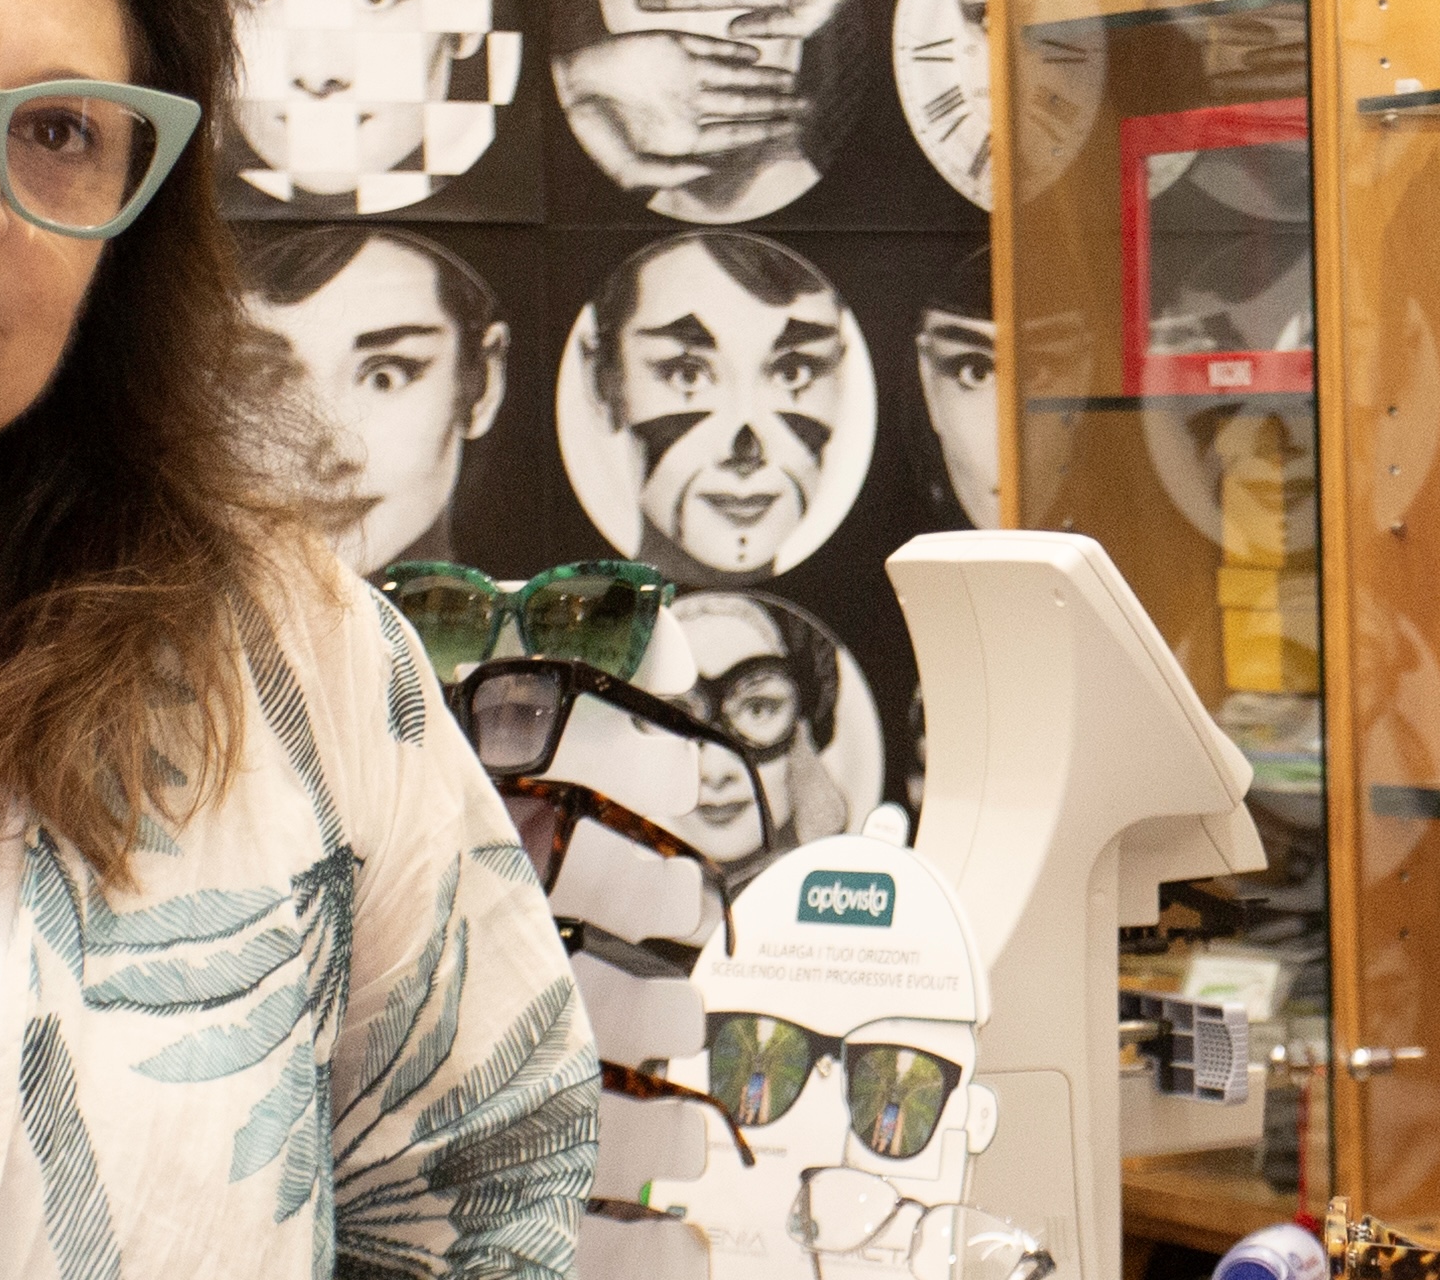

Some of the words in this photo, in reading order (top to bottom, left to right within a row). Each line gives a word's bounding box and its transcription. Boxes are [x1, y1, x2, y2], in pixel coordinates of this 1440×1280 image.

[807, 880, 889, 918] optovista
[758, 943, 814, 960] ALLARGA
[825, 945, 855, 963] TUOI
[857, 948, 920, 966] ORIZZONTI
[711, 962, 786, 981] SCEGLIENDO
[789, 967, 822, 983] LENTI
[825, 969, 903, 989] PROGRESSIVE
[906, 973, 960, 992] EVOLUTE
